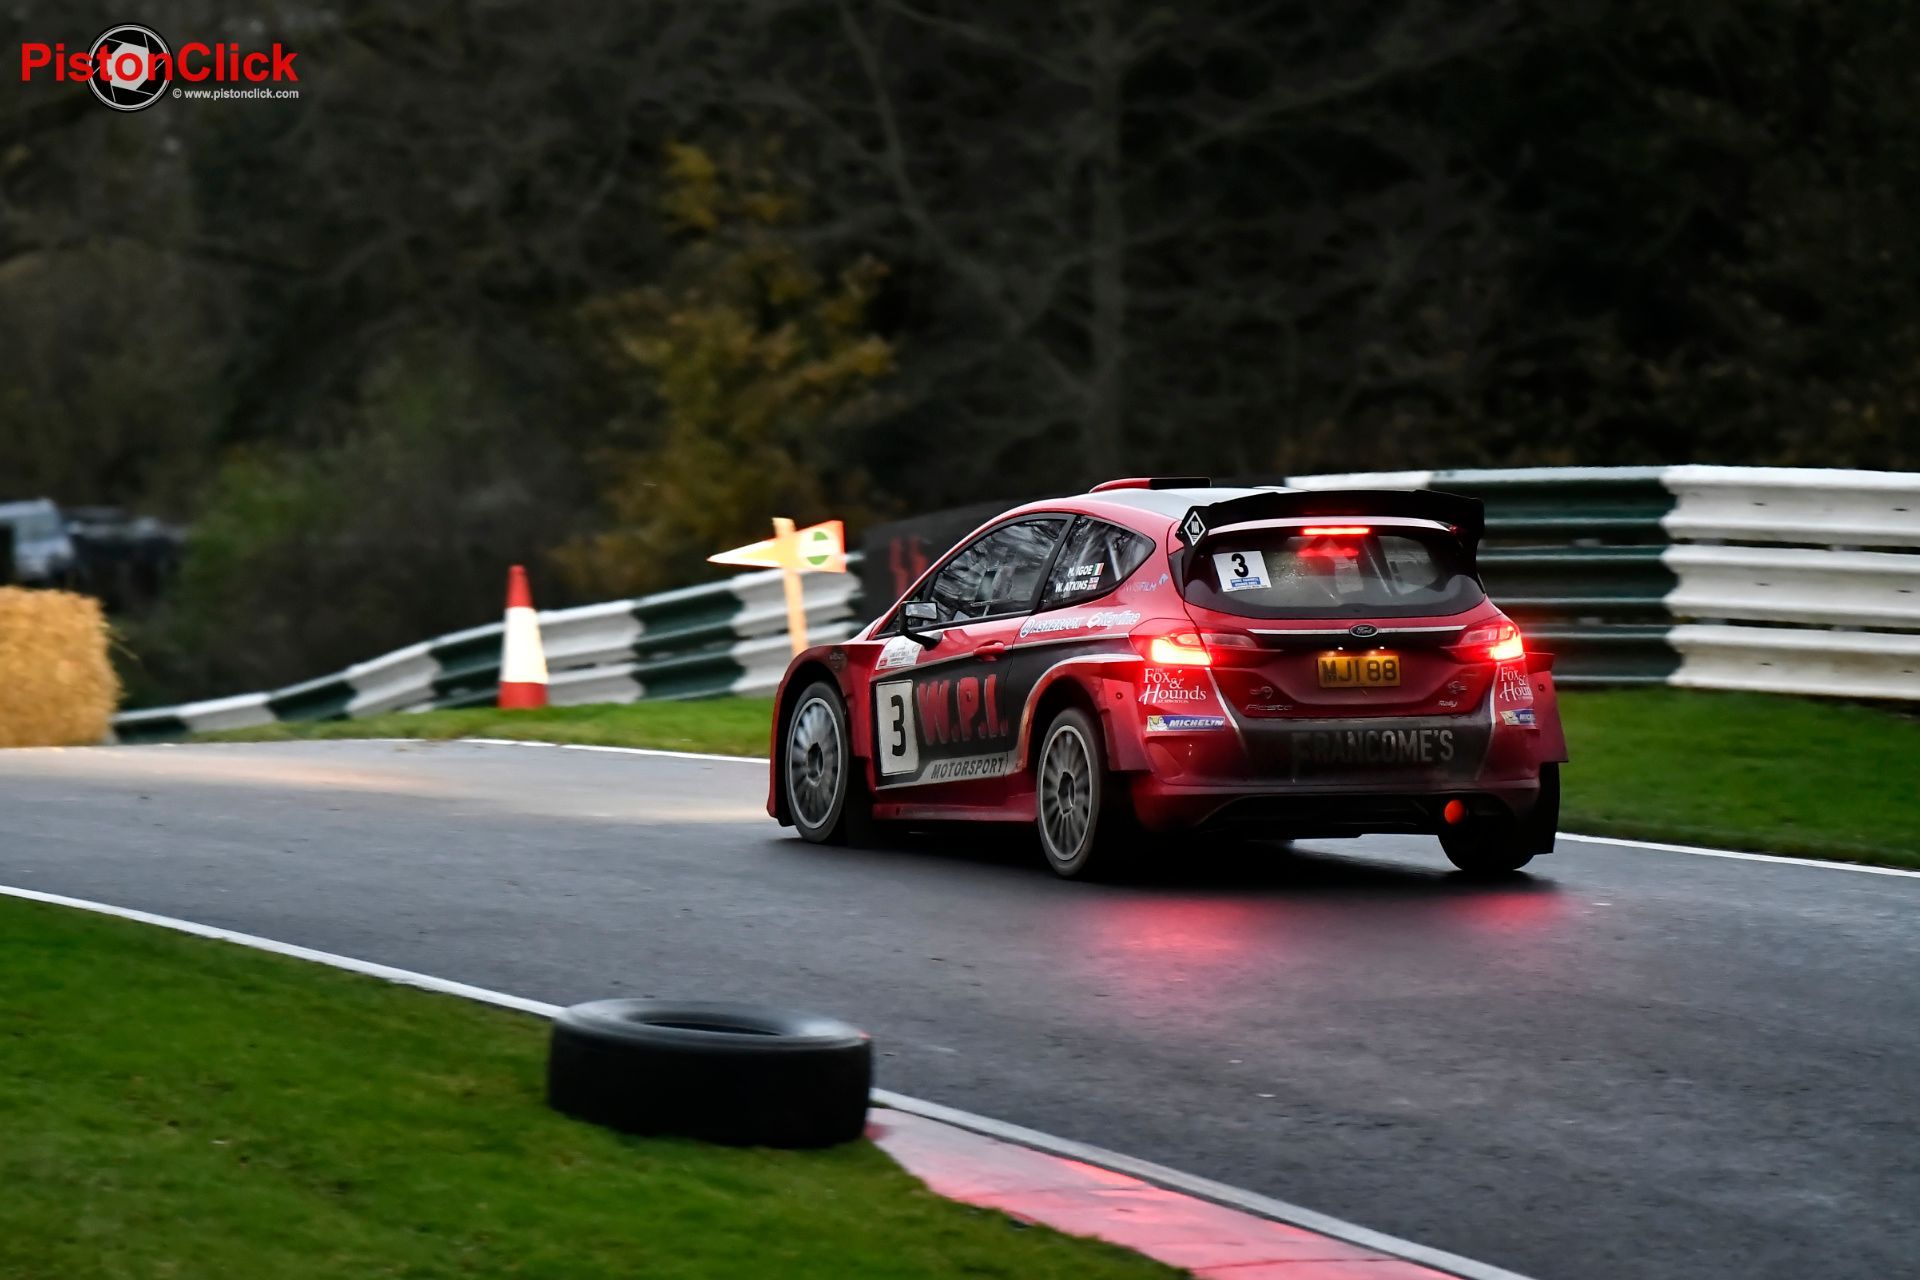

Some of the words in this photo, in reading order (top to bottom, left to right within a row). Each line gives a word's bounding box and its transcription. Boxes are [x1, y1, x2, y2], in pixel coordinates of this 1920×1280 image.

[1076, 564, 1093, 576] IGOE
[1231, 553, 1249, 577] 3
[1063, 580, 1088, 592] ATKINS
[1144, 668, 1170, 684] Fox
[1367, 660, 1396, 681] 88
[1500, 667, 1519, 681] Fox
[1138, 684, 1207, 705] Hounds
[891, 695, 906, 757] 3
[1169, 719, 1224, 728] MICHELIN
[930, 756, 1005, 780] MOTORSPORT
